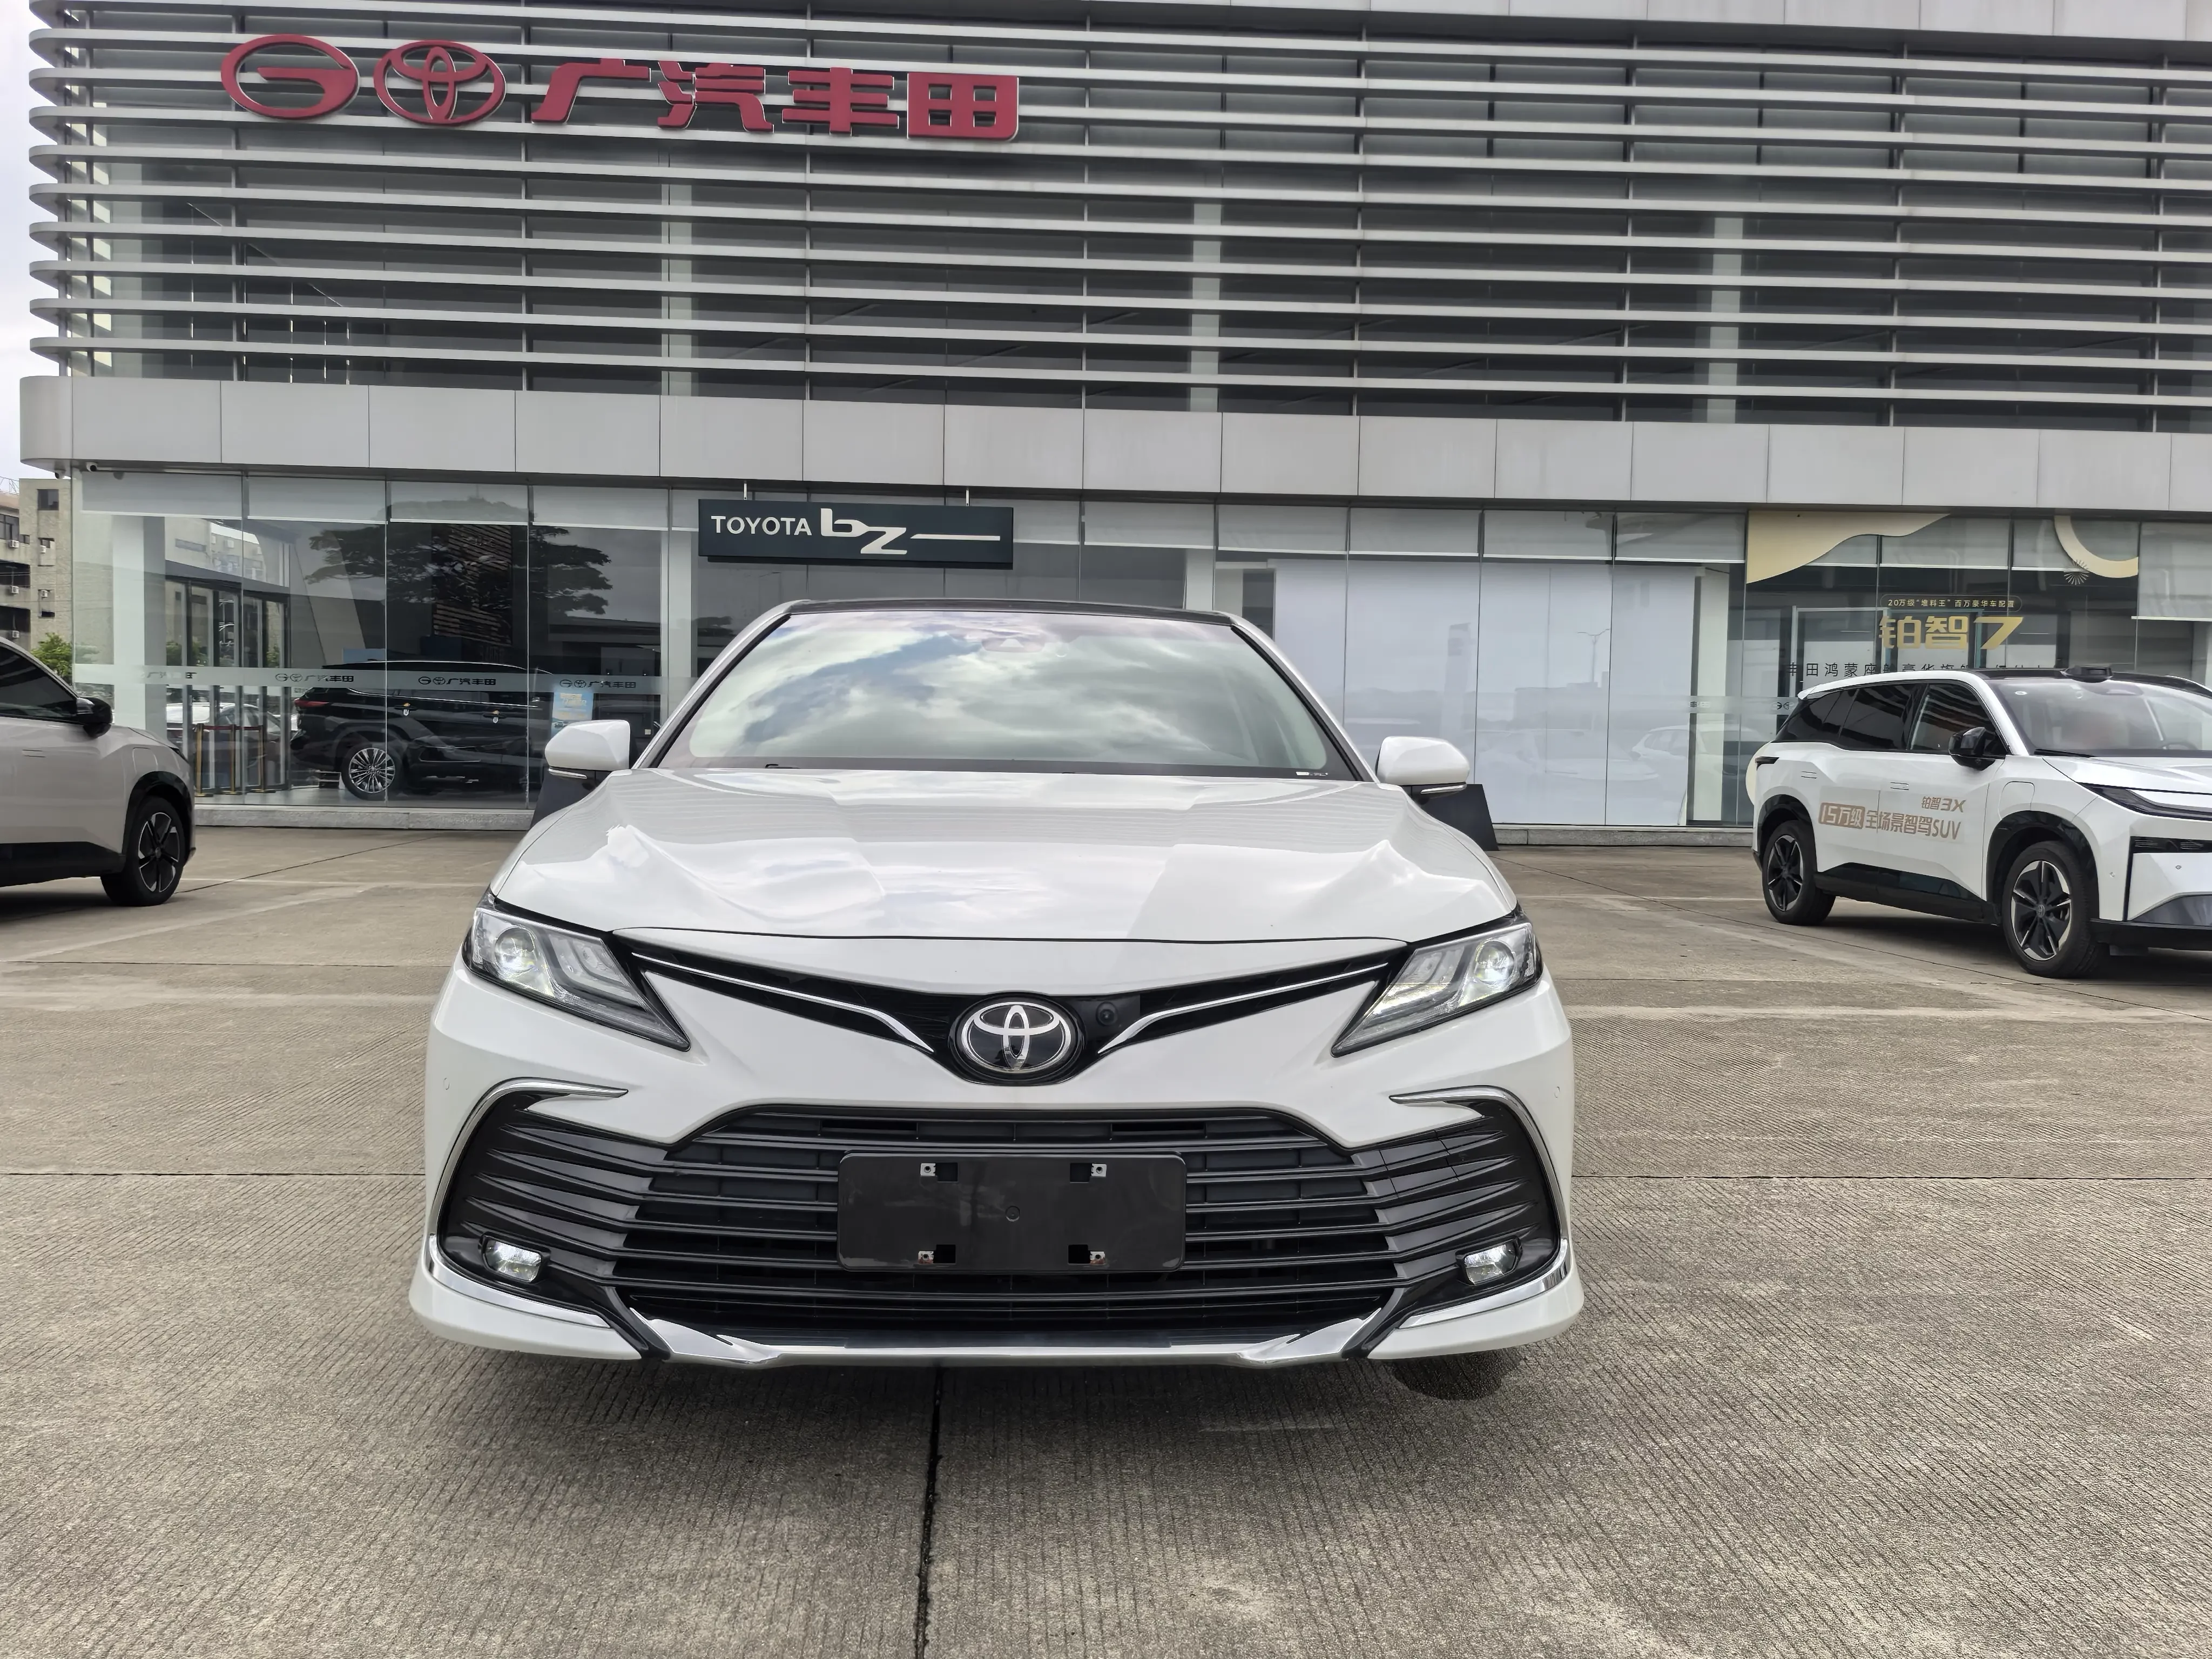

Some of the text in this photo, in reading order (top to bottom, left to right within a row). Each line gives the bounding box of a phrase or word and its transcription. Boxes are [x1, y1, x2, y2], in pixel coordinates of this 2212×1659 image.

[531, 58, 1019, 140] 广汽丰田
[711, 515, 812, 536] TOYOTA
[1879, 616, 2024, 650] 铂智7
[588, 680, 637, 689] 广汽丰田
[1921, 795, 1967, 813] 铂智3X
